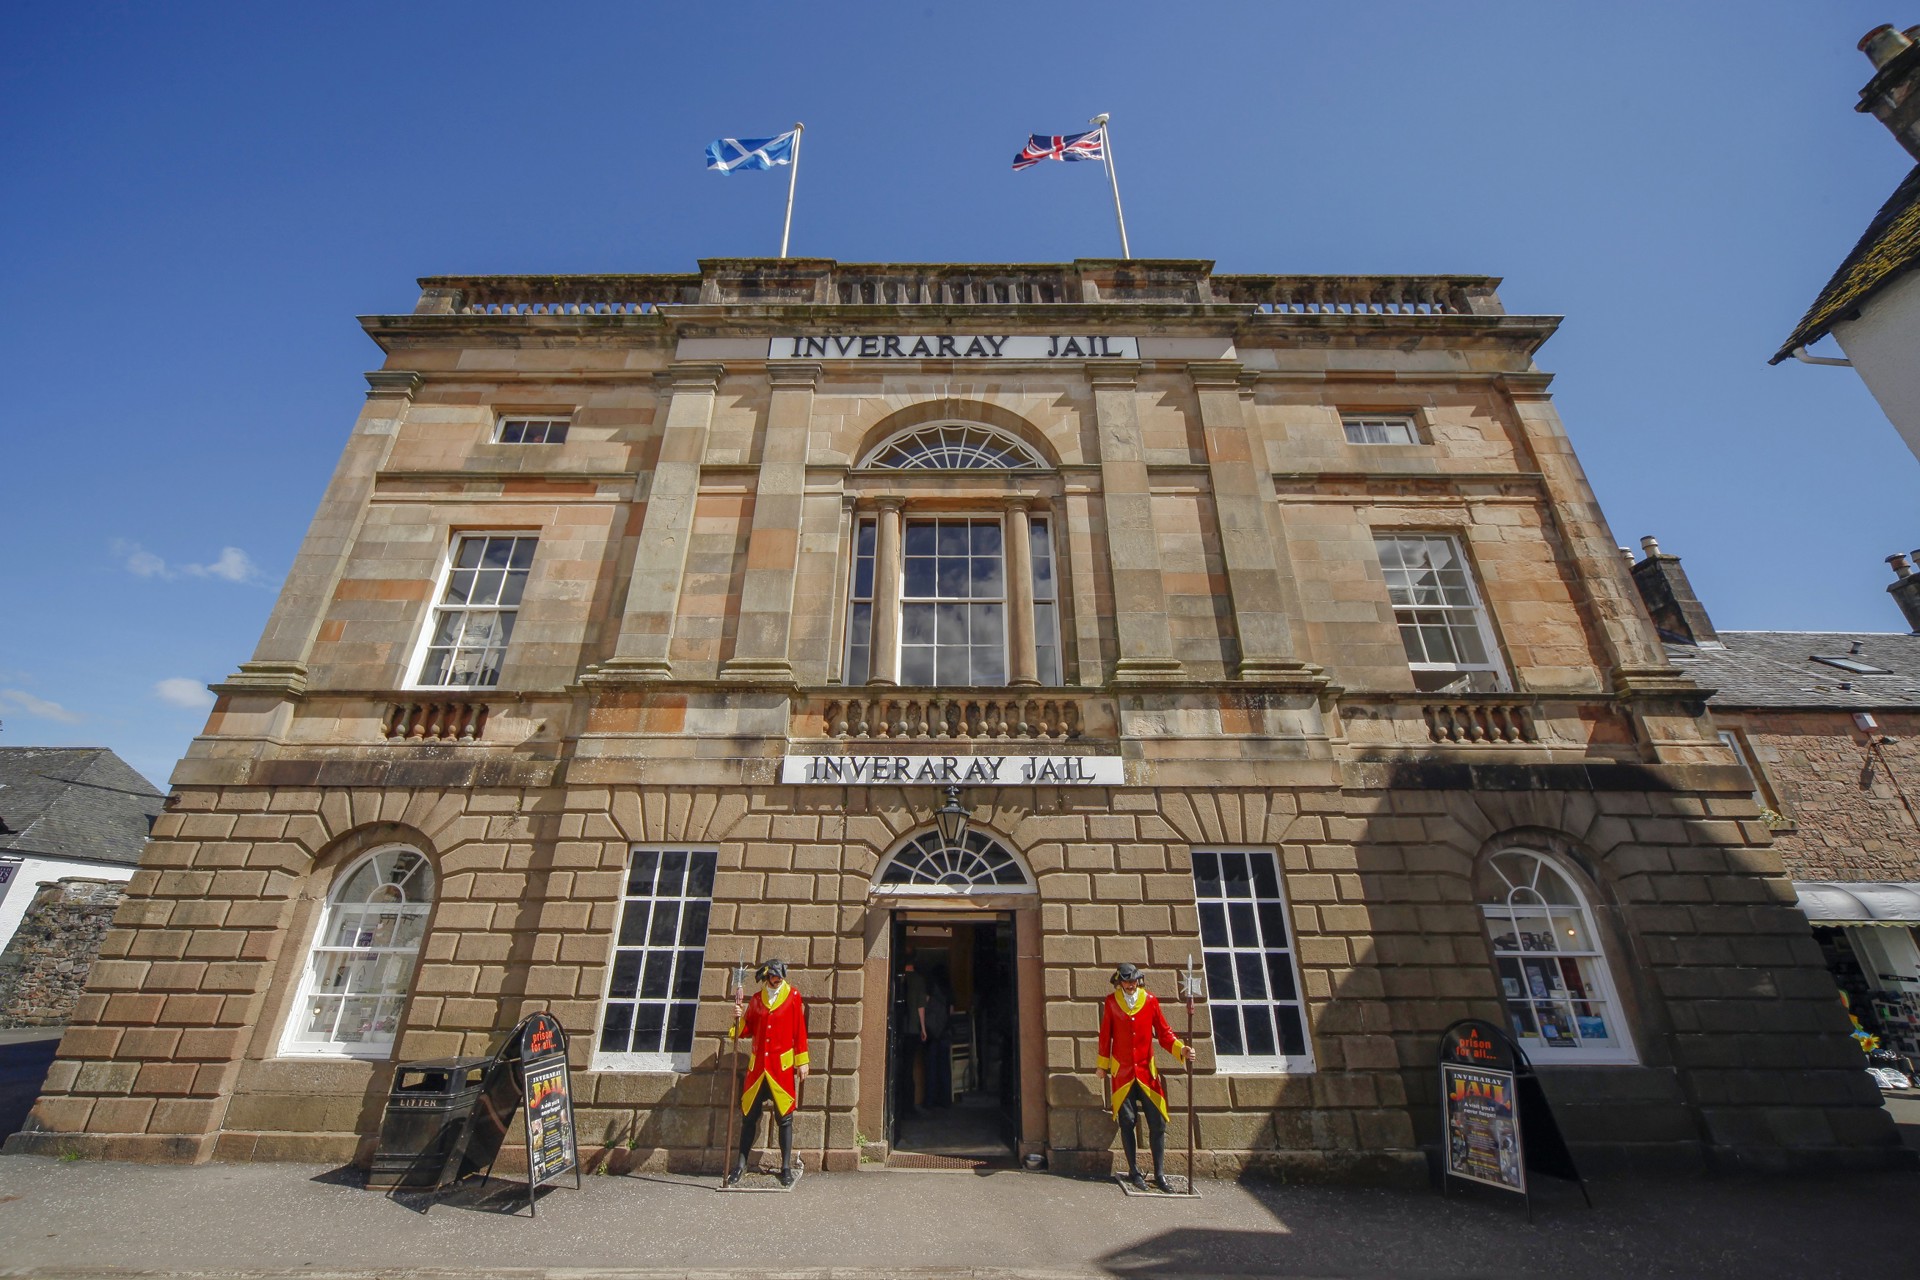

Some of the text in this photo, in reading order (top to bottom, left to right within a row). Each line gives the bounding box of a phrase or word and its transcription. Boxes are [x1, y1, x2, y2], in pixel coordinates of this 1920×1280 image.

[790, 335, 1124, 358] INVERARAY JAIL
[810, 756, 1097, 781] INVERARAY JAIL
[538, 1021, 545, 1030] A
[532, 1030, 554, 1043] prison
[1471, 1028, 1478, 1038] A
[531, 1042, 541, 1053] for
[1459, 1038, 1491, 1049] prison
[1456, 1046, 1470, 1057] for
[1454, 1073, 1502, 1085] INVERARAY
[530, 1076, 567, 1108] JAIL
[1449, 1079, 1511, 1110] JAIL
[400, 1099, 437, 1107] LITTER
